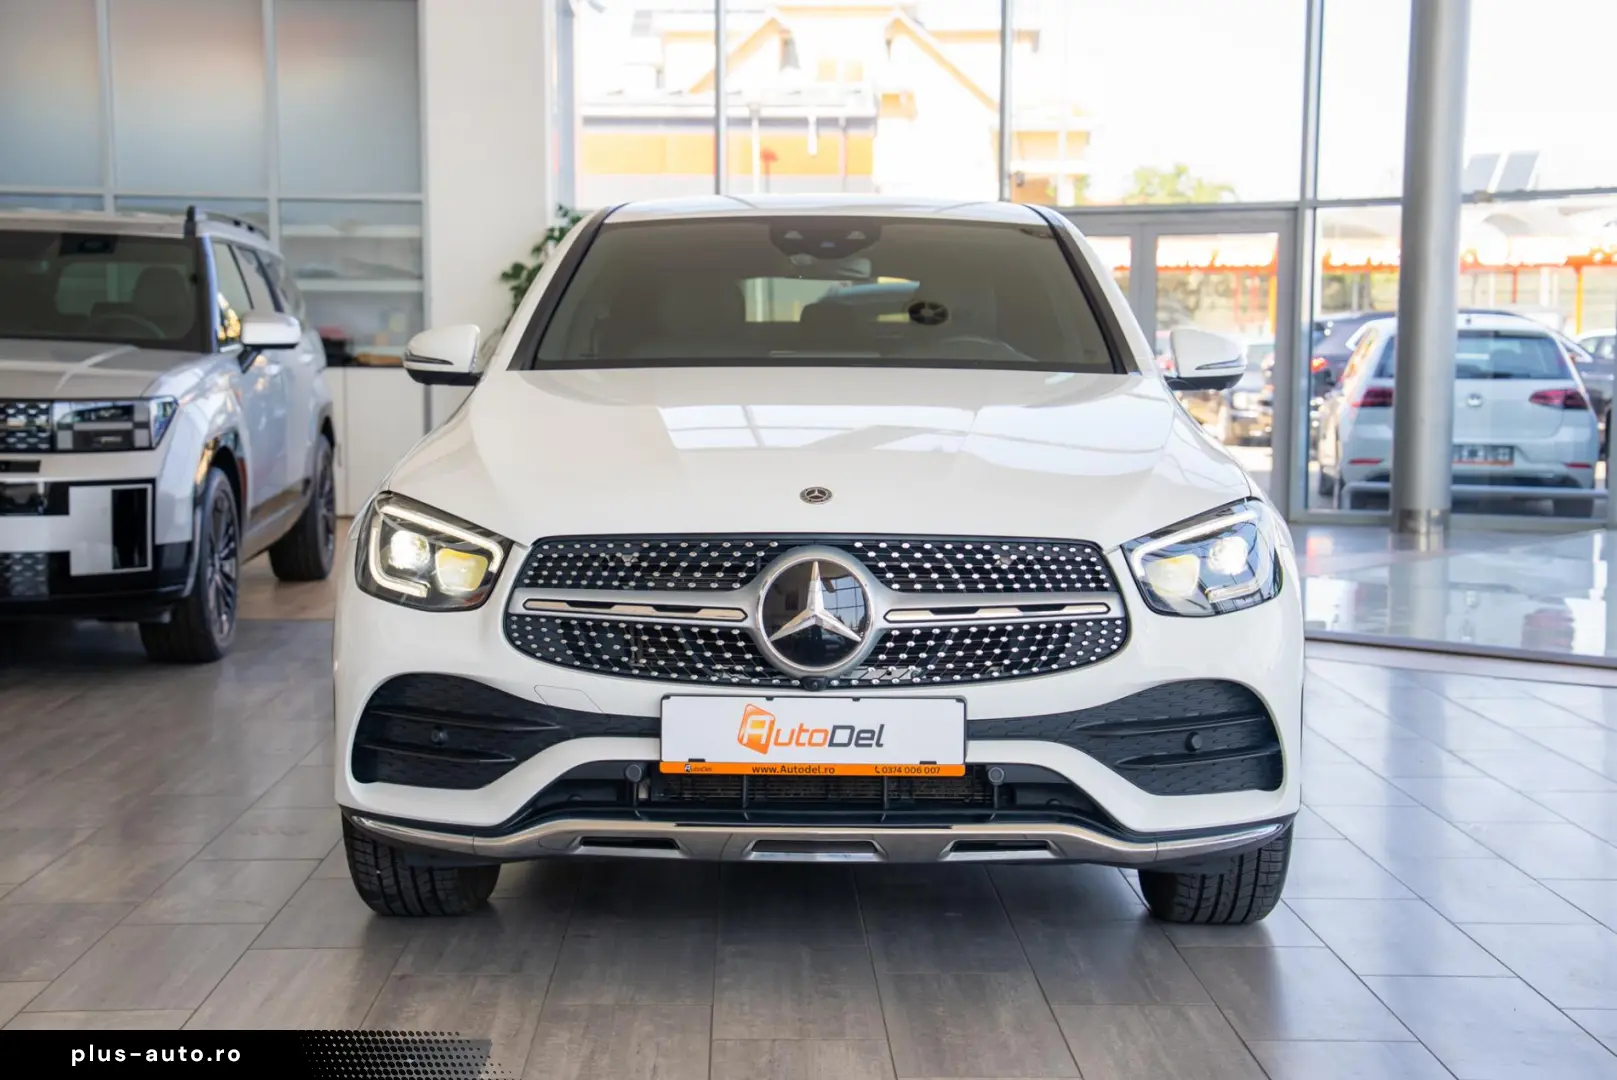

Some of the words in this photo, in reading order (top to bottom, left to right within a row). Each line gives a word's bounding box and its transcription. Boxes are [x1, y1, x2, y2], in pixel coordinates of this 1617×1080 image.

[739, 708, 885, 751] AutoDel
[751, 764, 836, 775] www.Autodel.ro
[882, 766, 903, 775] 0374
[904, 766, 923, 775] 006
[924, 766, 940, 775] 007
